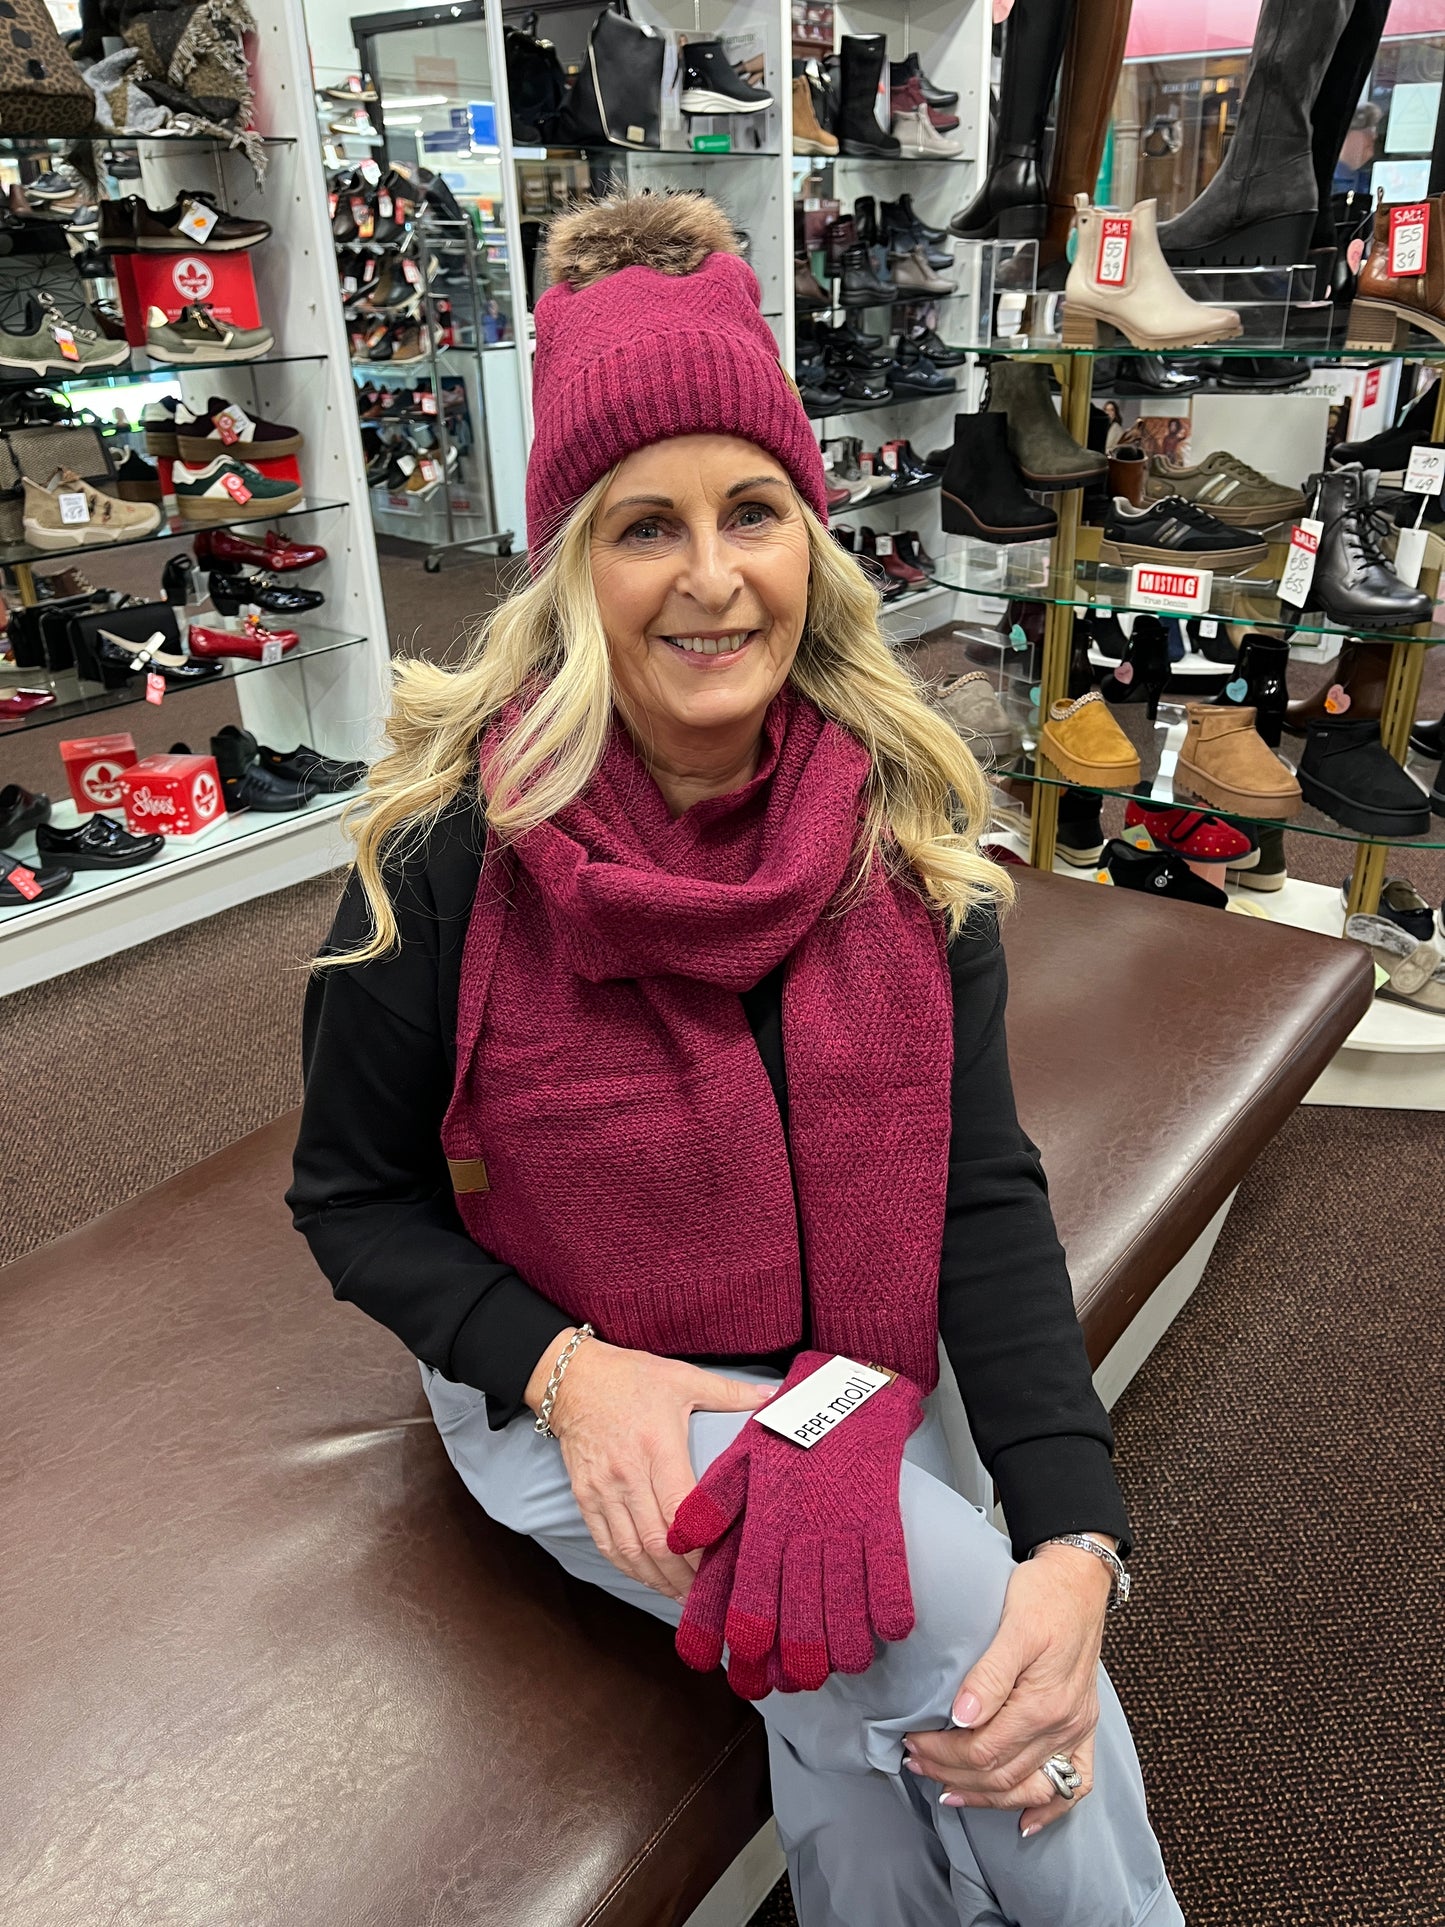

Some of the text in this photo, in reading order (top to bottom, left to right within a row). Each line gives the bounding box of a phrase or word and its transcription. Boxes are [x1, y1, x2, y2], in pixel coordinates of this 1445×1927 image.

[1398, 226, 1422, 245] 55
[1106, 241, 1123, 259] 55
[1396, 249, 1416, 269] 39
[1103, 261, 1120, 279] 39
[1293, 529, 1318, 548] SALE
[1140, 572, 1197, 596] MUSTANG
[1143, 596, 1189, 609] True Denim
[132, 786, 176, 817] Shoes
[794, 1376, 876, 1442] PEPE moll
